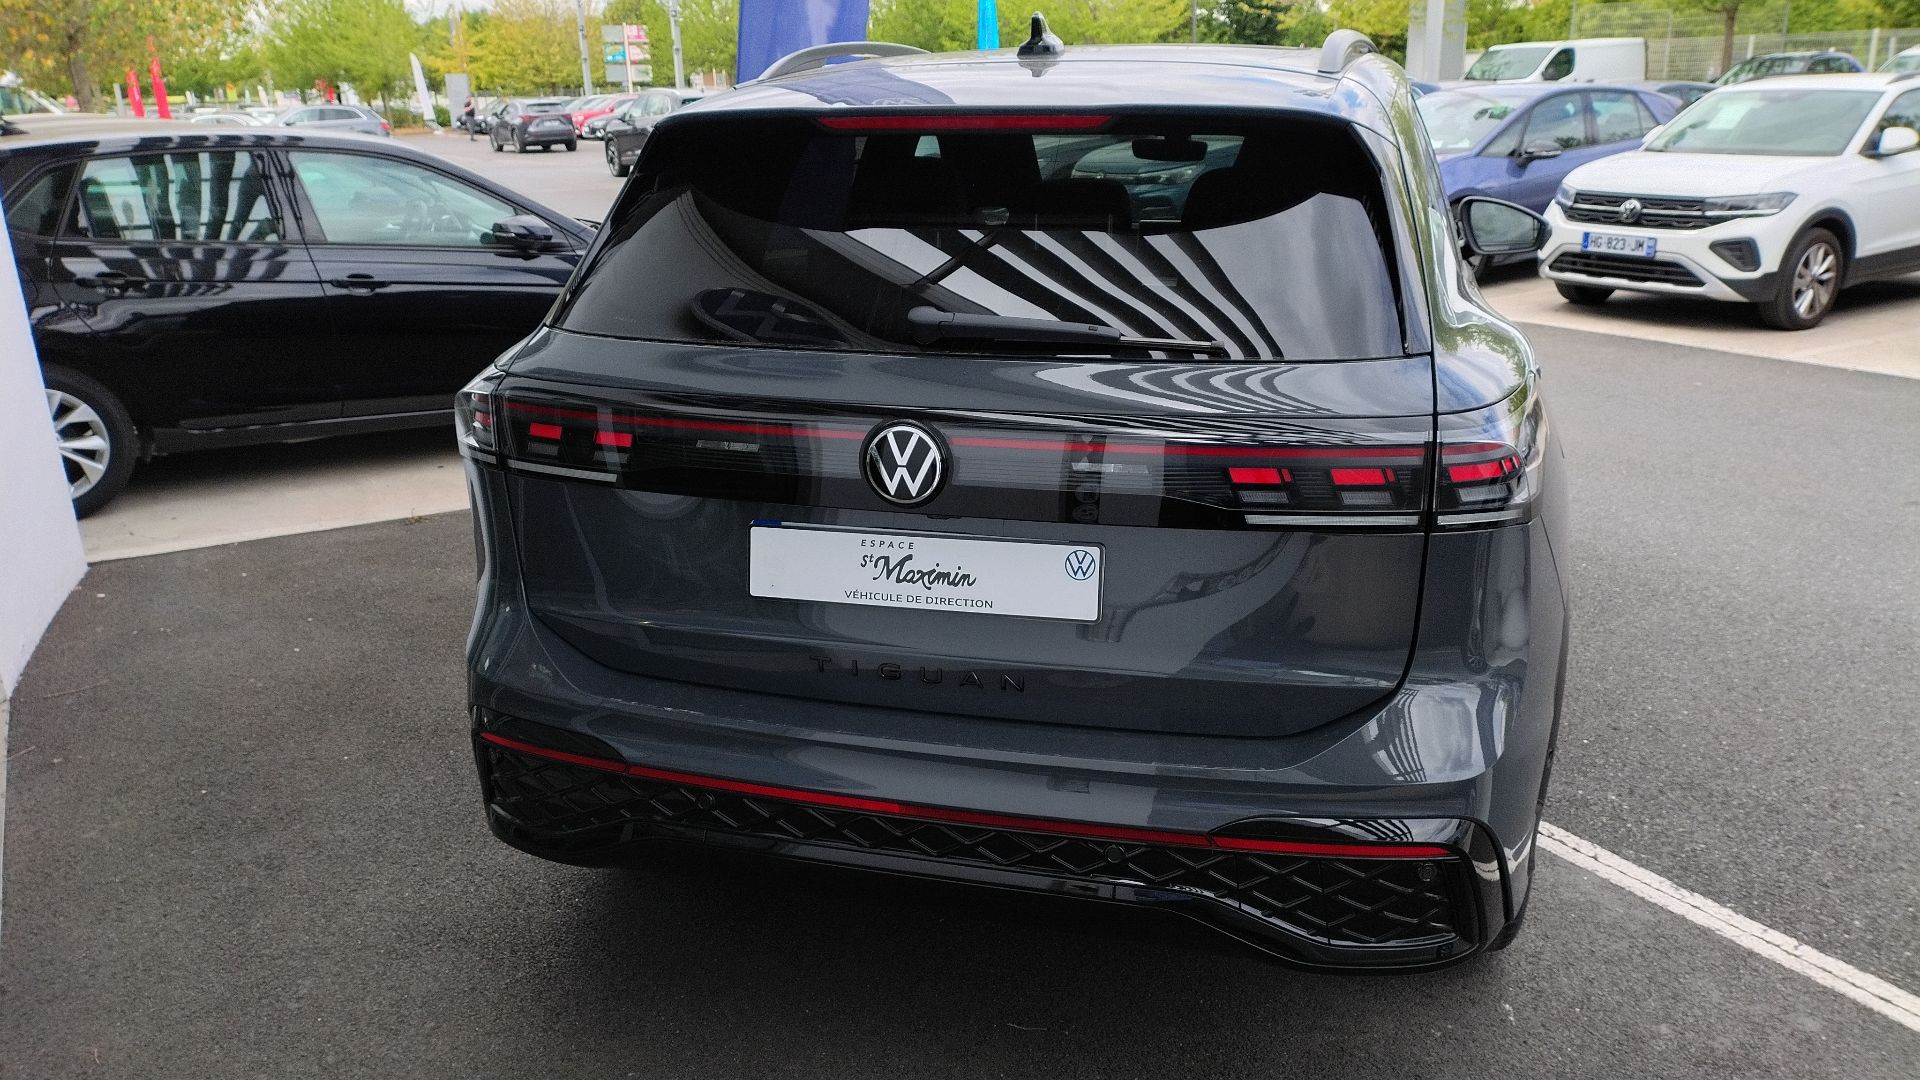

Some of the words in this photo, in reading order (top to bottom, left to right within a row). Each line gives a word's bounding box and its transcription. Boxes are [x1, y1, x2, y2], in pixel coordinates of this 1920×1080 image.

[860, 539, 915, 550] ESPACE
[872, 553, 977, 591] Maximin
[844, 589, 903, 603] VÉHICULE
[906, 595, 922, 604] DE
[925, 596, 993, 609] DIRECTION
[809, 655, 1025, 693] TIGUAN
